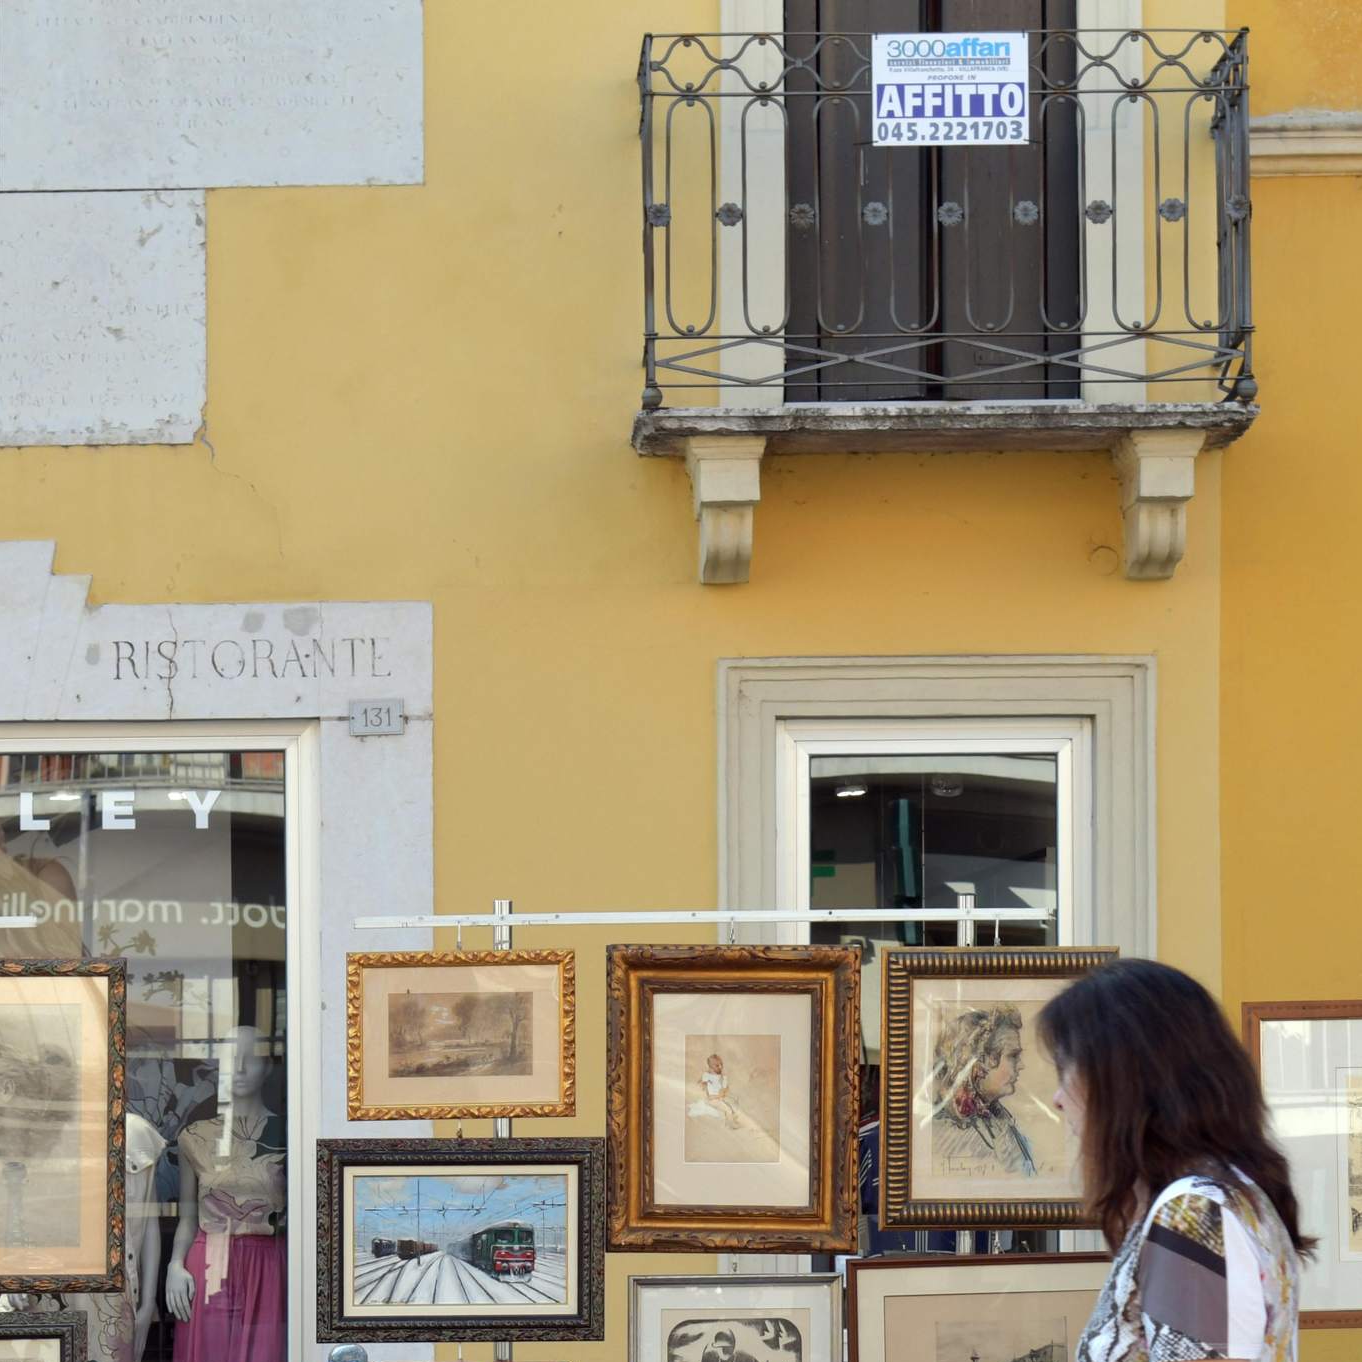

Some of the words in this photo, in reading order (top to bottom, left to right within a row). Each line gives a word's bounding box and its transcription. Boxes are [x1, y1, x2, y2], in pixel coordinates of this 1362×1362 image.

[879, 83, 1023, 117] AFFITTO
[877, 120, 1023, 141] 045.2221703
[112, 637, 392, 680] RISTORANTE
[363, 707, 392, 727] 131
